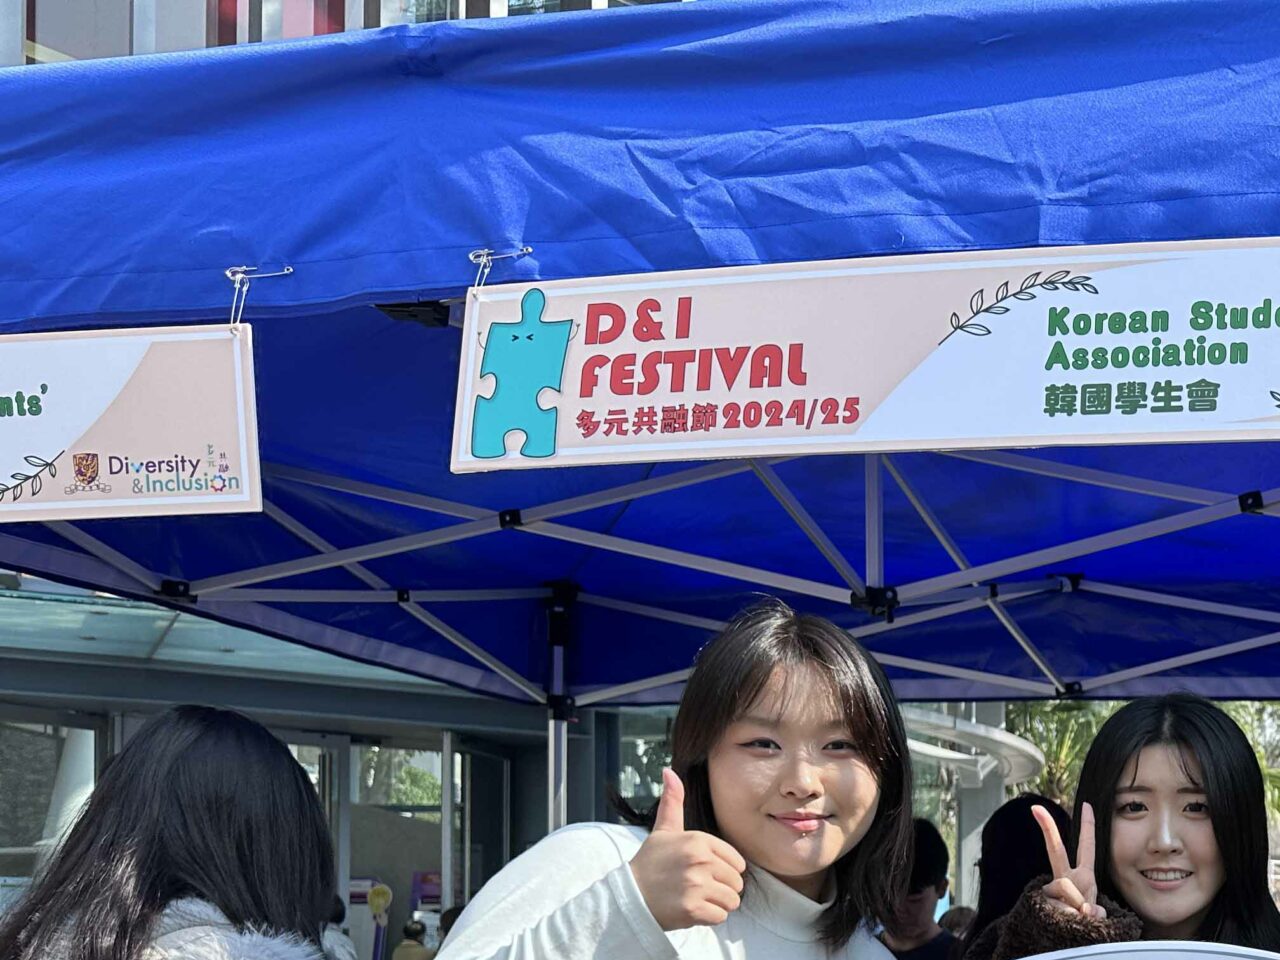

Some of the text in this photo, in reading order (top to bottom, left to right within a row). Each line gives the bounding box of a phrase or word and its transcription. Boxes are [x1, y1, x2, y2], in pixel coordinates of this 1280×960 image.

[1047, 305, 1170, 336] Korean
[579, 343, 807, 398] FESTIVAL
[1045, 337, 1249, 371] Association
[1044, 378, 1221, 417] 韓國學生會
[108, 454, 201, 478] Diversity
